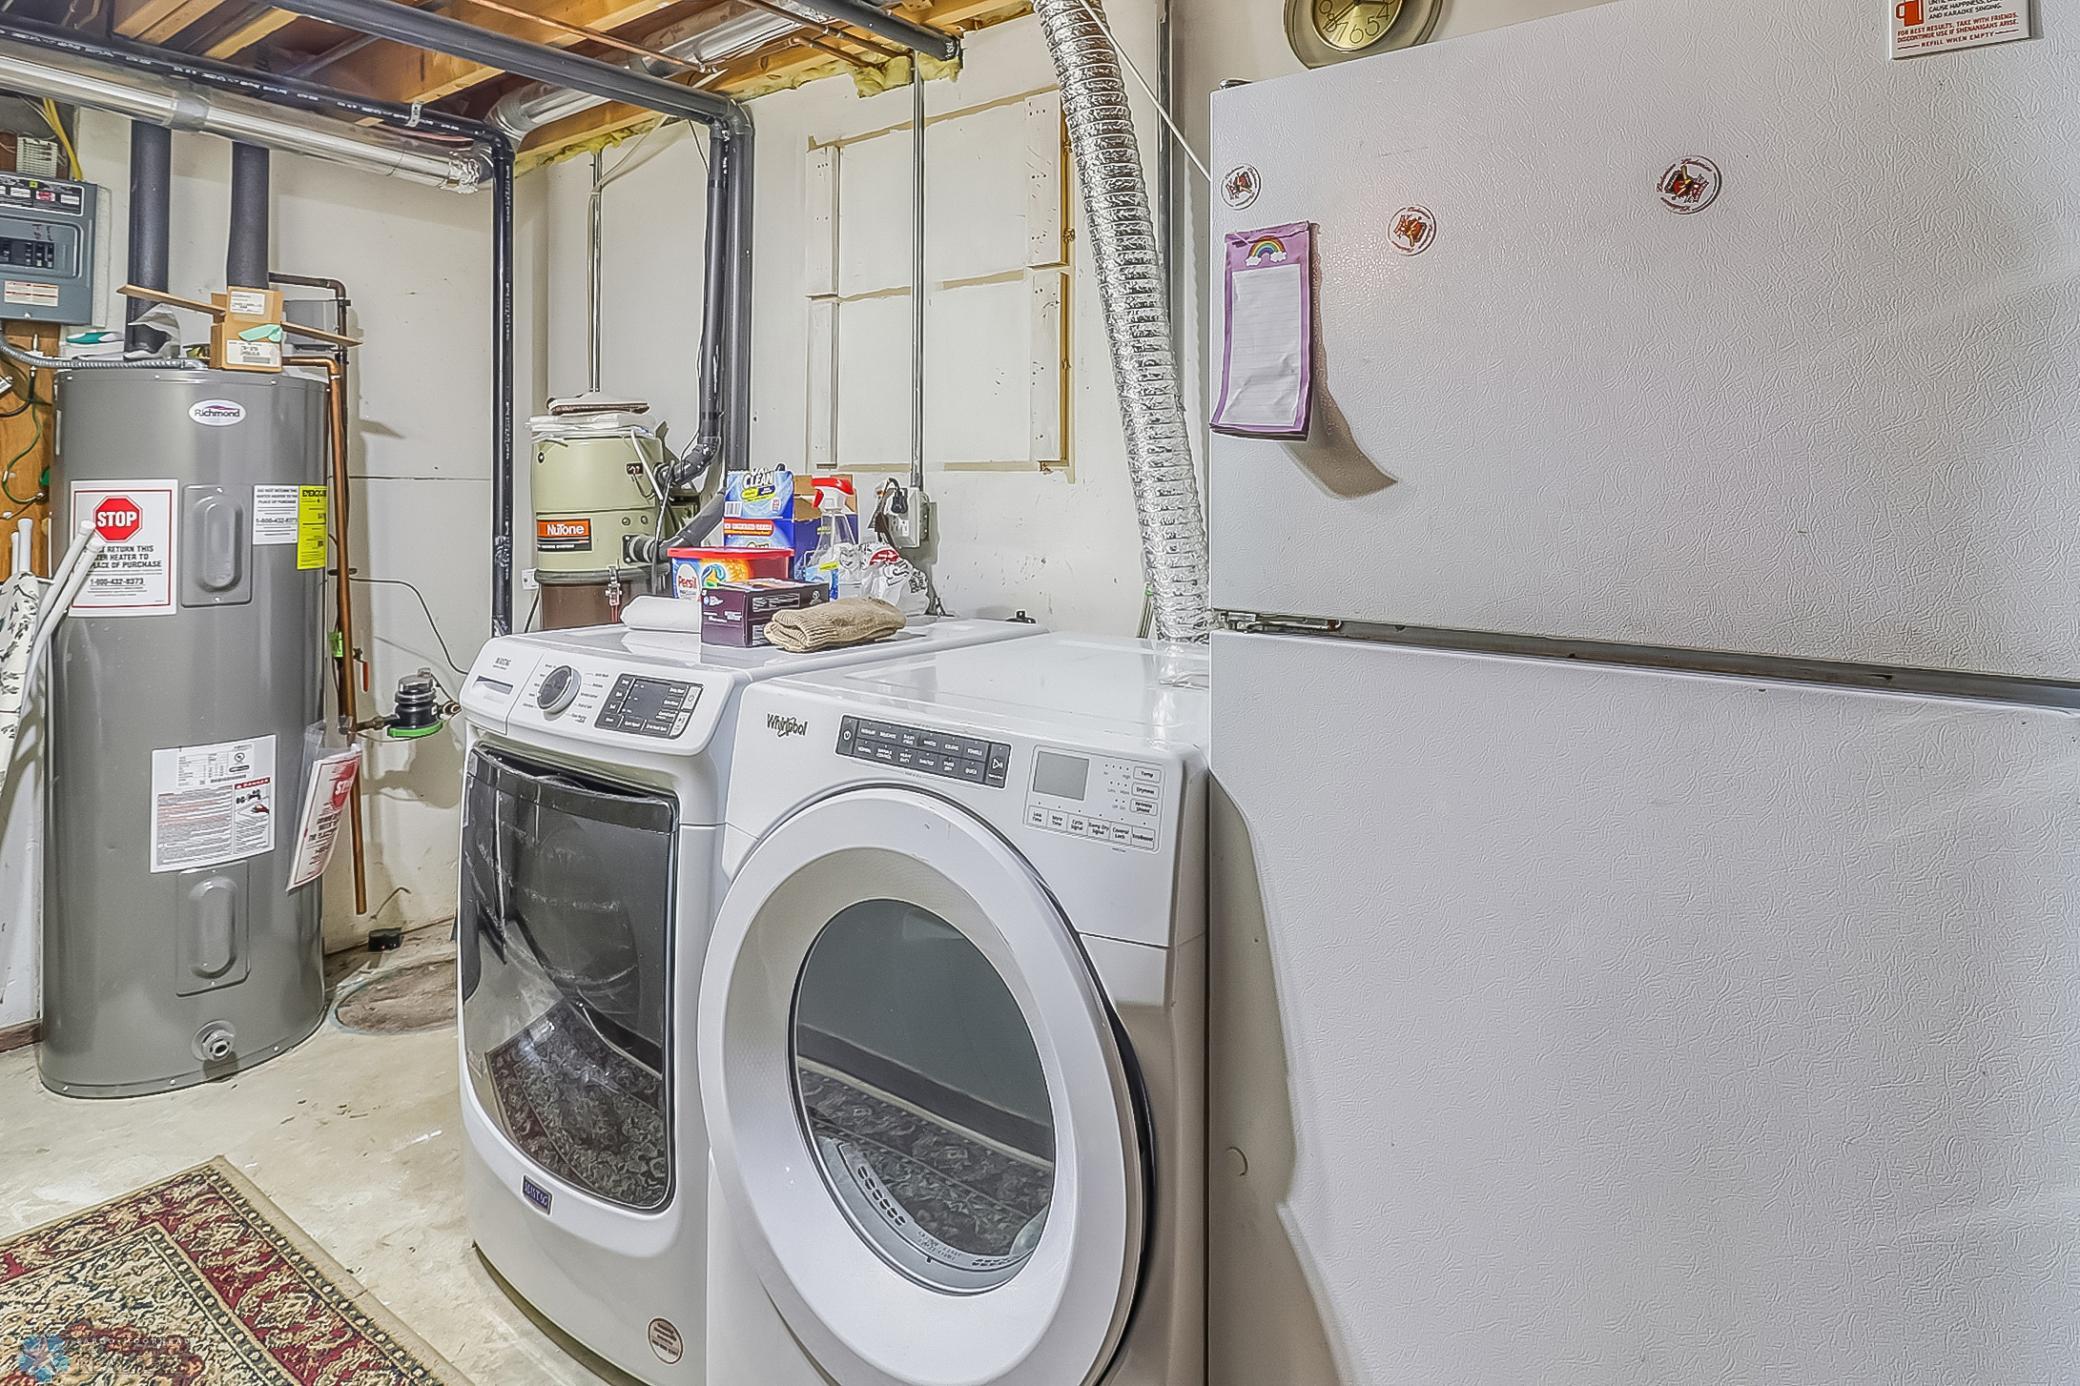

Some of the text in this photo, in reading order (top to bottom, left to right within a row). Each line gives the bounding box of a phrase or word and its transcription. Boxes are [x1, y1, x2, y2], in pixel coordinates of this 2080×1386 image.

[1944, 8, 1974, 16] KARAOKE
[1364, 16, 1380, 36] 5
[1974, 16, 1990, 24] WITH
[1350, 24, 1364, 44] 6
[1897, 32, 1935, 43] DISCONTINUE
[1956, 22, 1998, 34] SHENANIGANS
[1921, 32, 1995, 47] REFILL WHEN EMPTY
[194, 408, 240, 417] Richmond
[744, 470, 774, 489] CLEAN
[97, 511, 137, 527] STOP
[547, 523, 585, 536] NuTone
[678, 576, 698, 589] Persil
[767, 713, 808, 738] Whirlpool
